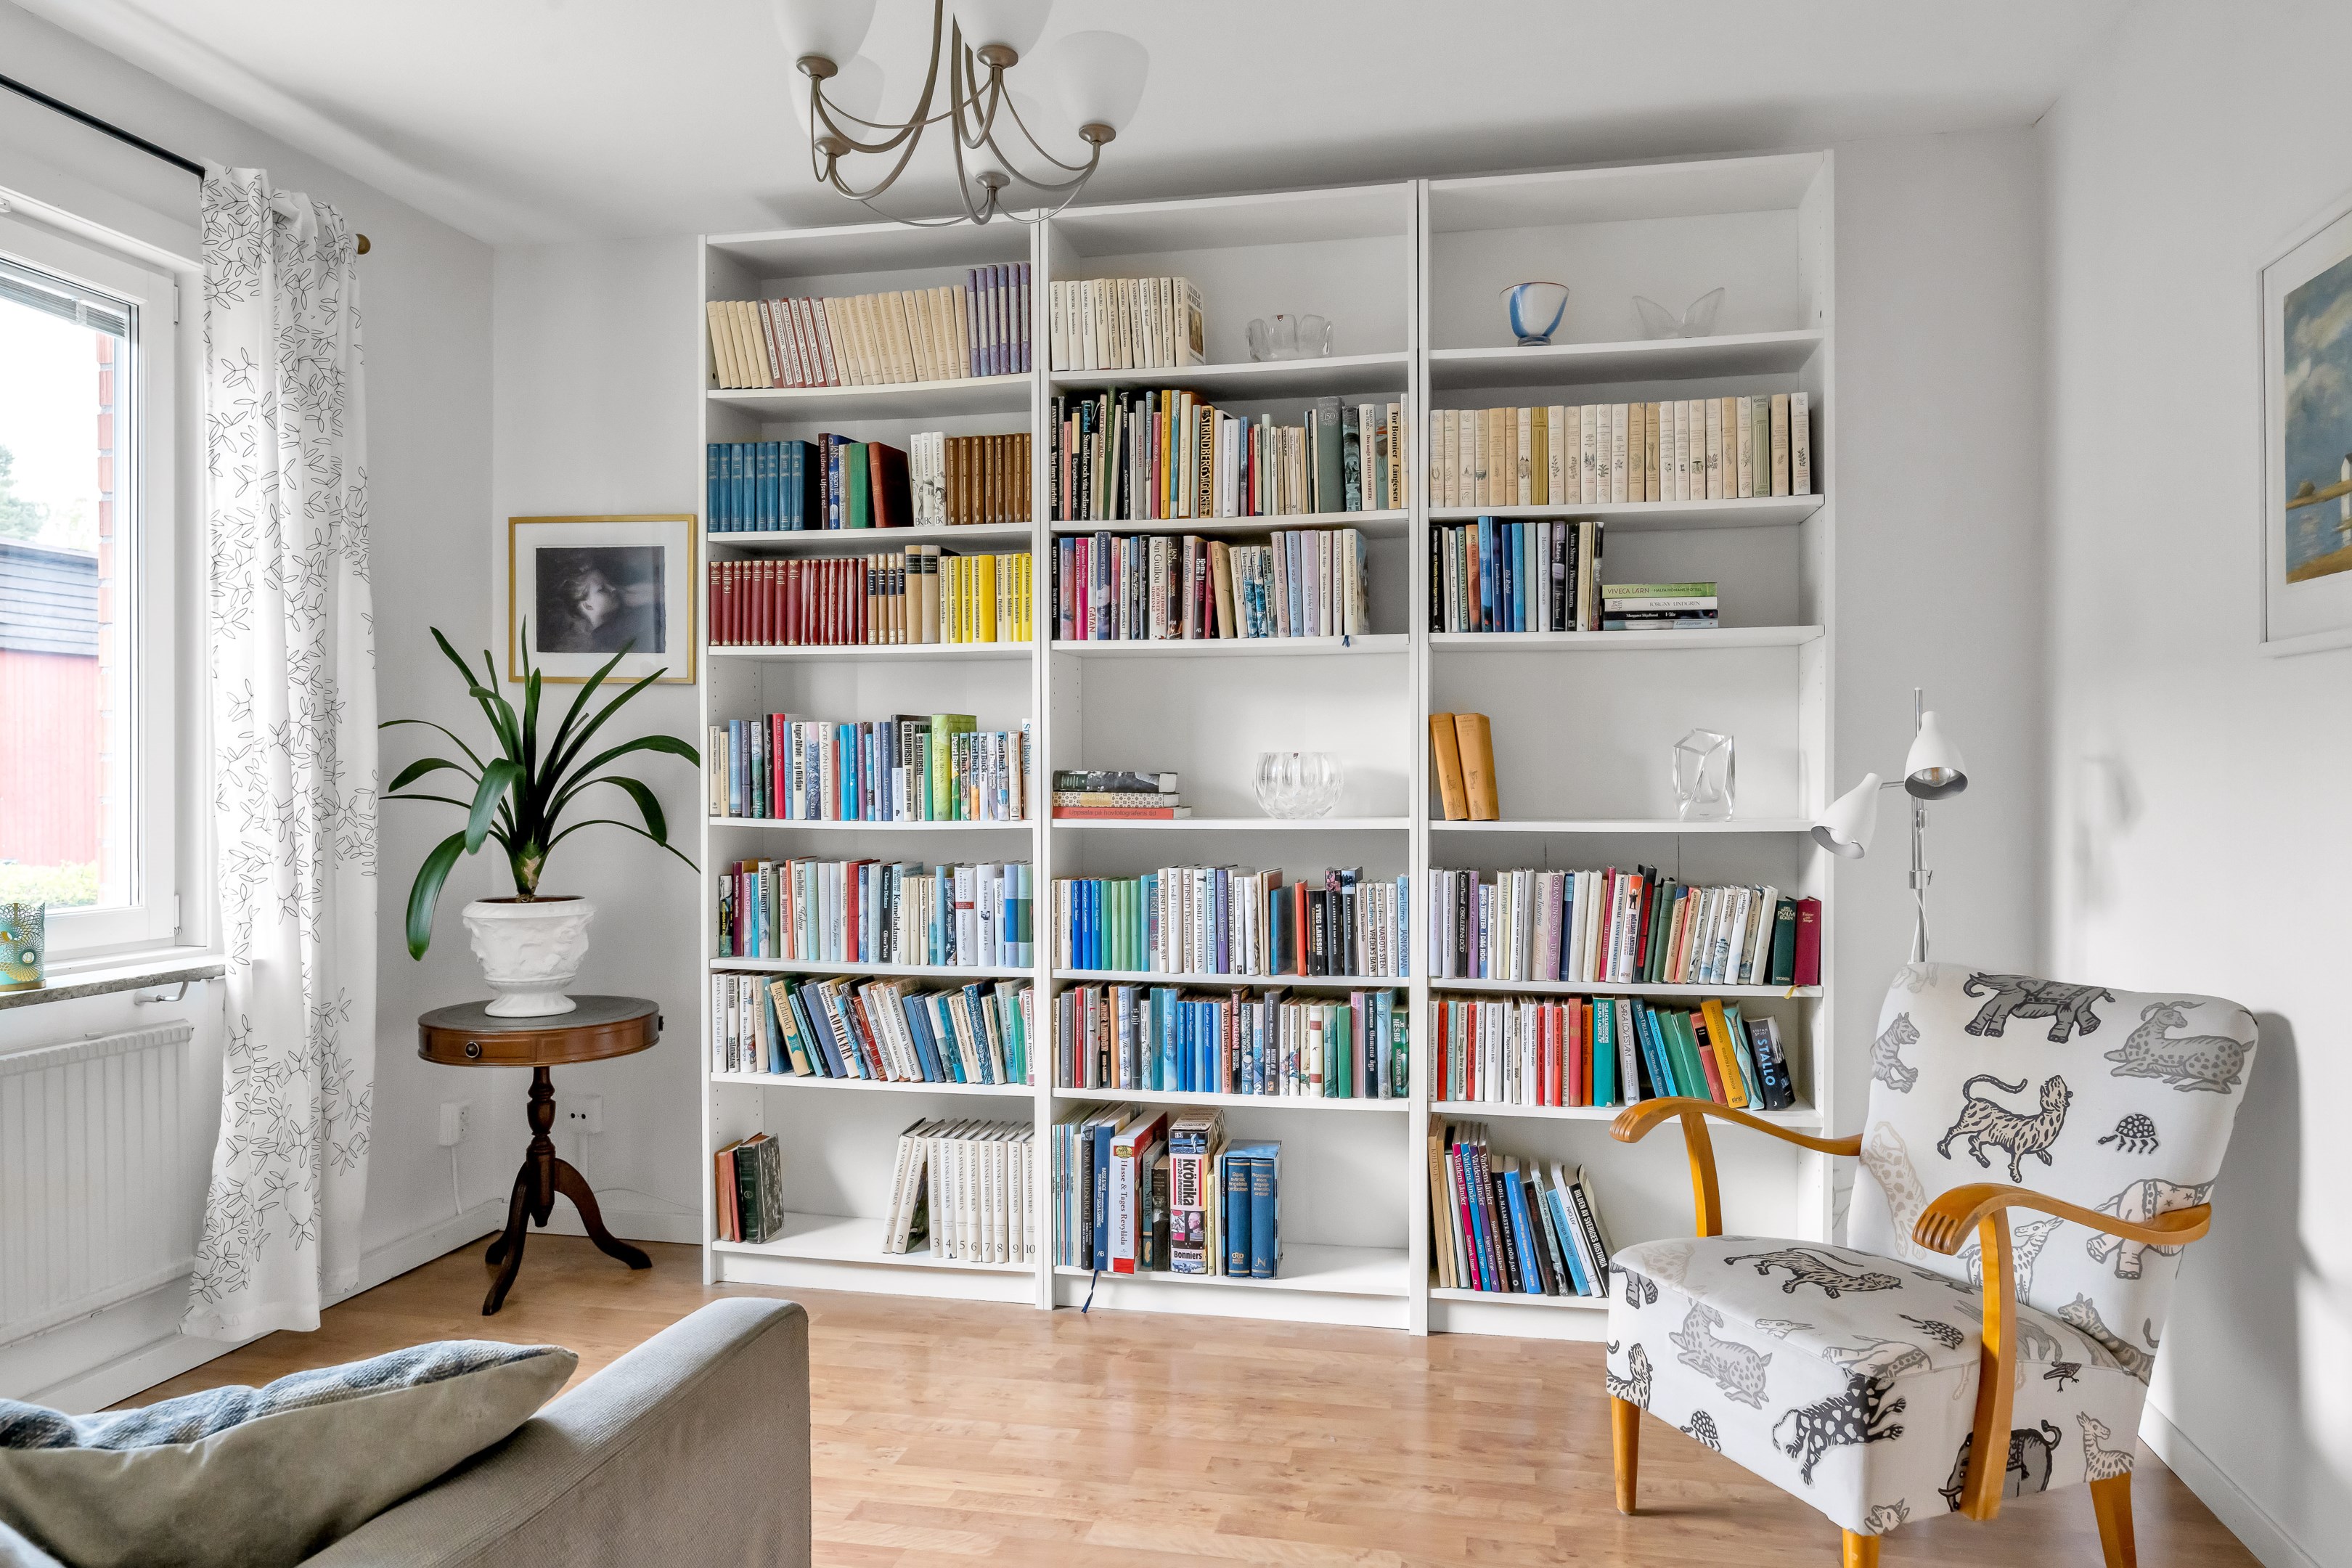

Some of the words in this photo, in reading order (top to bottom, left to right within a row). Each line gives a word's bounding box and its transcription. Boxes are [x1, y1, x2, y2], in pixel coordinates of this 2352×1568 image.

[764, 322, 773, 346] JOHANSSON
[793, 724, 802, 739] Inger
[904, 724, 912, 732] BO
[773, 985, 783, 1002] Tage
[778, 1003, 793, 1030] Erlander
[829, 1013, 853, 1061] KOMIKERN
[870, 1019, 892, 1071] SVENSSONS
[1757, 1039, 1776, 1086] STALLO
[1454, 1153, 1463, 1183] Världens
[1479, 1153, 1490, 1182] Världens
[905, 1178, 914, 1206] HISTORIEN
[1183, 1159, 1194, 1206] Krönika
[1458, 1185, 1467, 1206] länder
[1483, 1184, 1493, 1205] länder
[1119, 1214, 1128, 1245] Revylåda
[1500, 1201, 1510, 1233] MALMSTEN
[1551, 1196, 1559, 1214] Himla
[1556, 1214, 1567, 1236] många
[1562, 1236, 1575, 1257] kungar
[1573, 1189, 1586, 1209] BILDEN
[1583, 1216, 1598, 1243] SVERIGES
[1592, 1242, 1607, 1268] HISTORIA
[898, 1235, 904, 1244] 2
[1026, 1244, 1035, 1254] 10
[1174, 1250, 1202, 1260] Bonniers
